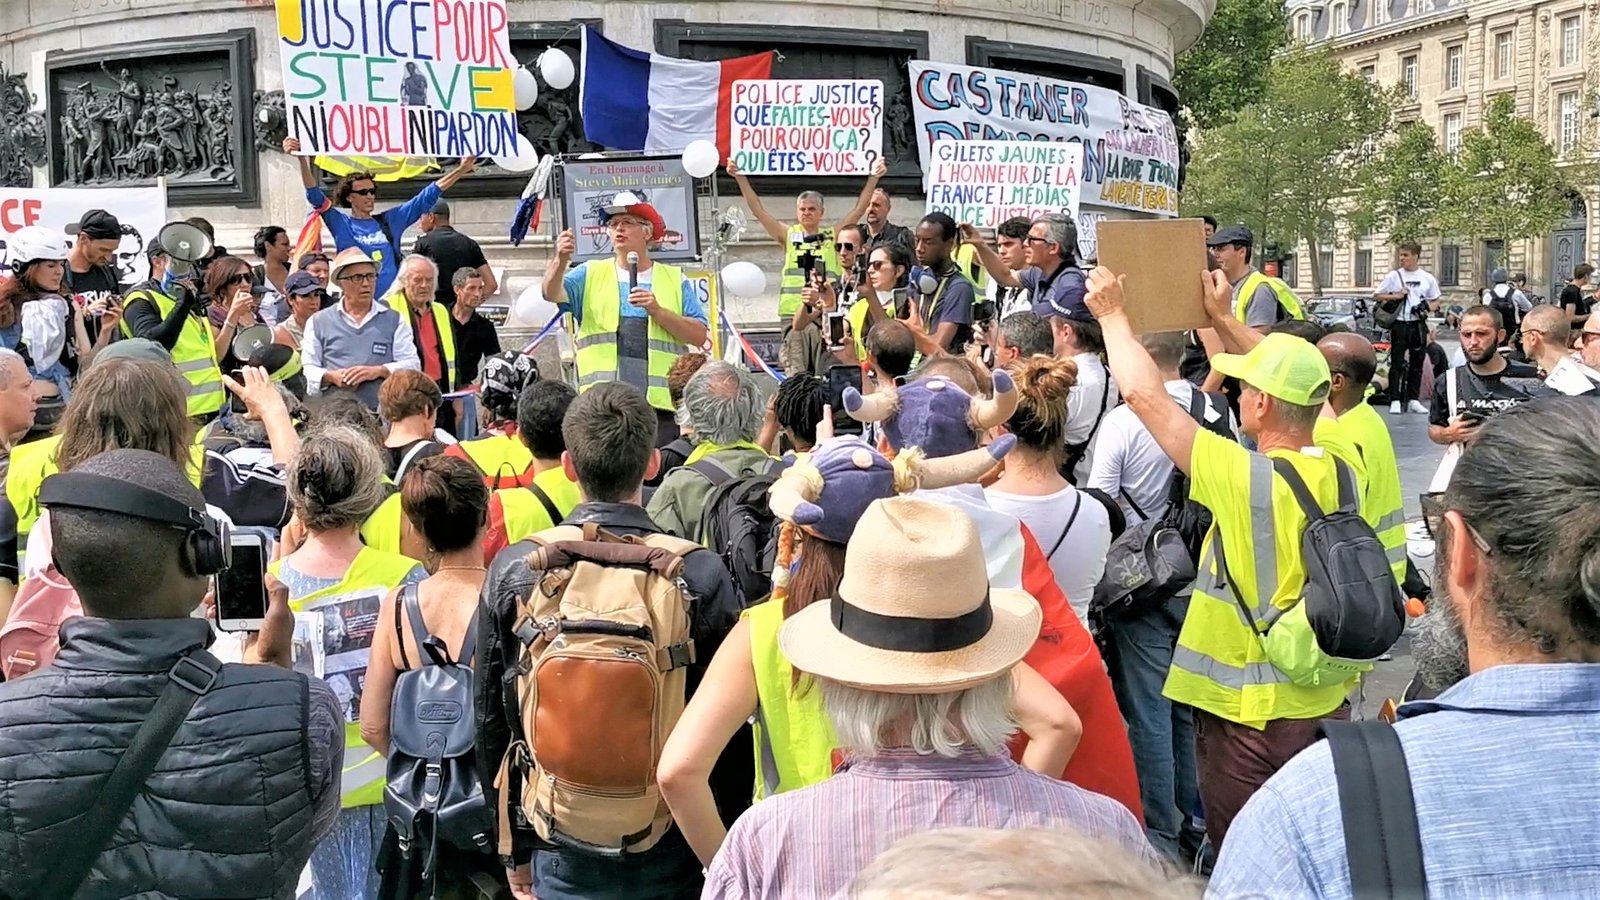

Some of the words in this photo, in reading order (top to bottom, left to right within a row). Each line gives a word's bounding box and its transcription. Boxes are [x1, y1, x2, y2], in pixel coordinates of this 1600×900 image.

[282, 0, 433, 60] JUSTICE
[433, 0, 509, 69] POUR
[289, 51, 509, 113] STEVE
[735, 81, 803, 105] POLICE
[809, 82, 880, 106] JUSTICE
[916, 69, 1090, 128] CASTANER
[734, 104, 771, 126] QUE
[292, 101, 330, 153] NI
[328, 104, 410, 154] OUBLI
[408, 104, 436, 155] NI
[434, 109, 519, 158] PARDON
[739, 124, 831, 151] POURQUOI
[832, 127, 871, 154] ÇA?
[734, 151, 765, 173] QUI
[938, 142, 995, 163] GILETS
[998, 146, 1067, 165] JAUNES
[1106, 152, 1119, 179] LA
[575, 177, 608, 188] Steve
[611, 175, 640, 187] Maia
[589, 165, 604, 175] En
[607, 163, 656, 176] Hommage
[658, 163, 665, 173] à
[937, 162, 1029, 184] L'HONNEUR
[1032, 165, 1053, 185] DE
[1055, 166, 1077, 186] LA
[930, 184, 996, 205] FRANCE
[1011, 183, 1072, 207] MÉDIAS
